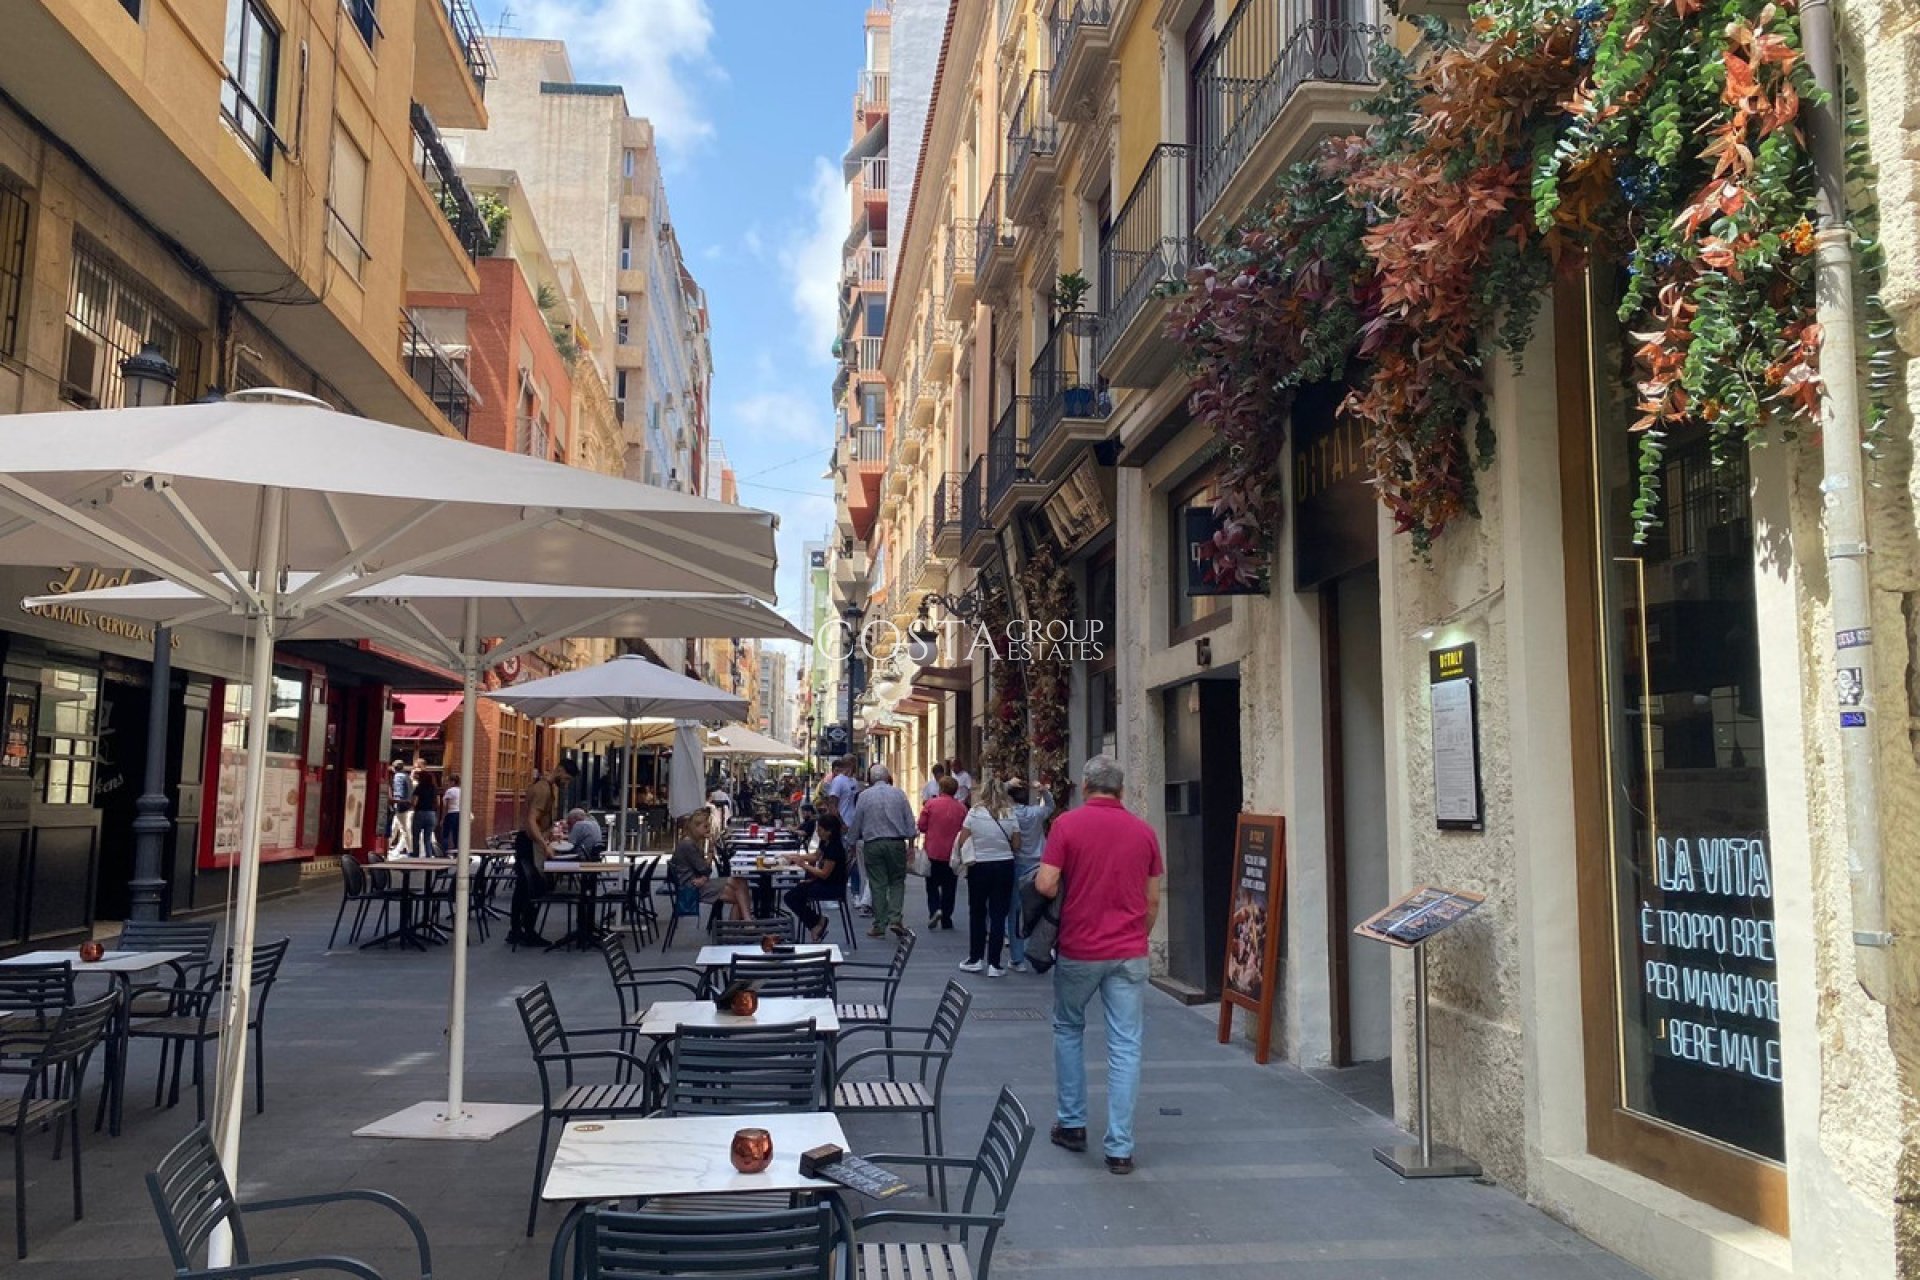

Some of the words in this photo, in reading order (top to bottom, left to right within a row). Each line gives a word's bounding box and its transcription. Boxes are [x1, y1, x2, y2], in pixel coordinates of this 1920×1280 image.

[99, 614, 143, 641] CERVEZA
[1657, 836, 1695, 892] LA
[1698, 837, 1771, 898] VITA
[1641, 900, 1657, 945] È
[1657, 909, 1726, 954] TROPPO
[1645, 960, 1680, 1002] PER
[1682, 967, 1780, 1023] MANGIARE
[1669, 1018, 1721, 1067] BERE
[1720, 1028, 1782, 1083] MALE
